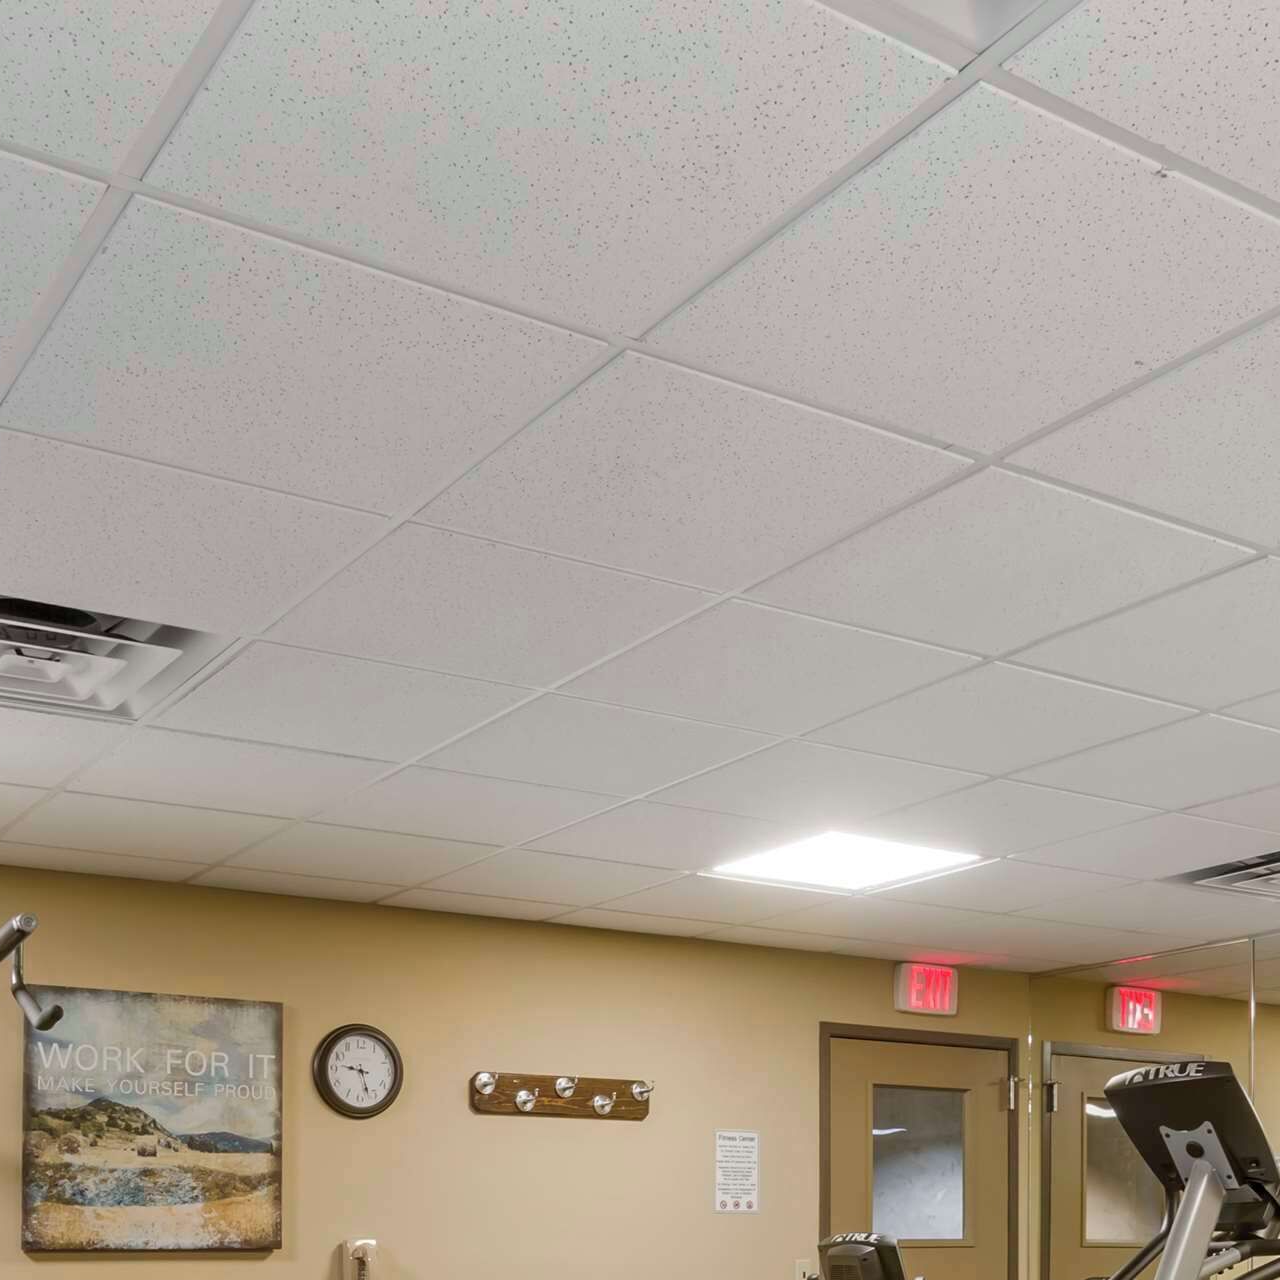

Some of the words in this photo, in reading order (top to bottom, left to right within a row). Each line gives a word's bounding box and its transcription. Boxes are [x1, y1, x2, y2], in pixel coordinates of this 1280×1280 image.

[911, 965, 953, 1012] EXIT
[37, 1041, 145, 1073] WORK
[166, 1049, 230, 1079] FOR
[248, 1053, 276, 1079] IT
[1145, 1062, 1206, 1080] TRUE
[37, 1075, 96, 1093] MAKE
[106, 1078, 207, 1097] YOURSELF
[214, 1083, 276, 1100] PROUD
[718, 1134, 738, 1142] Fitness
[845, 1232, 881, 1244] TRUE
